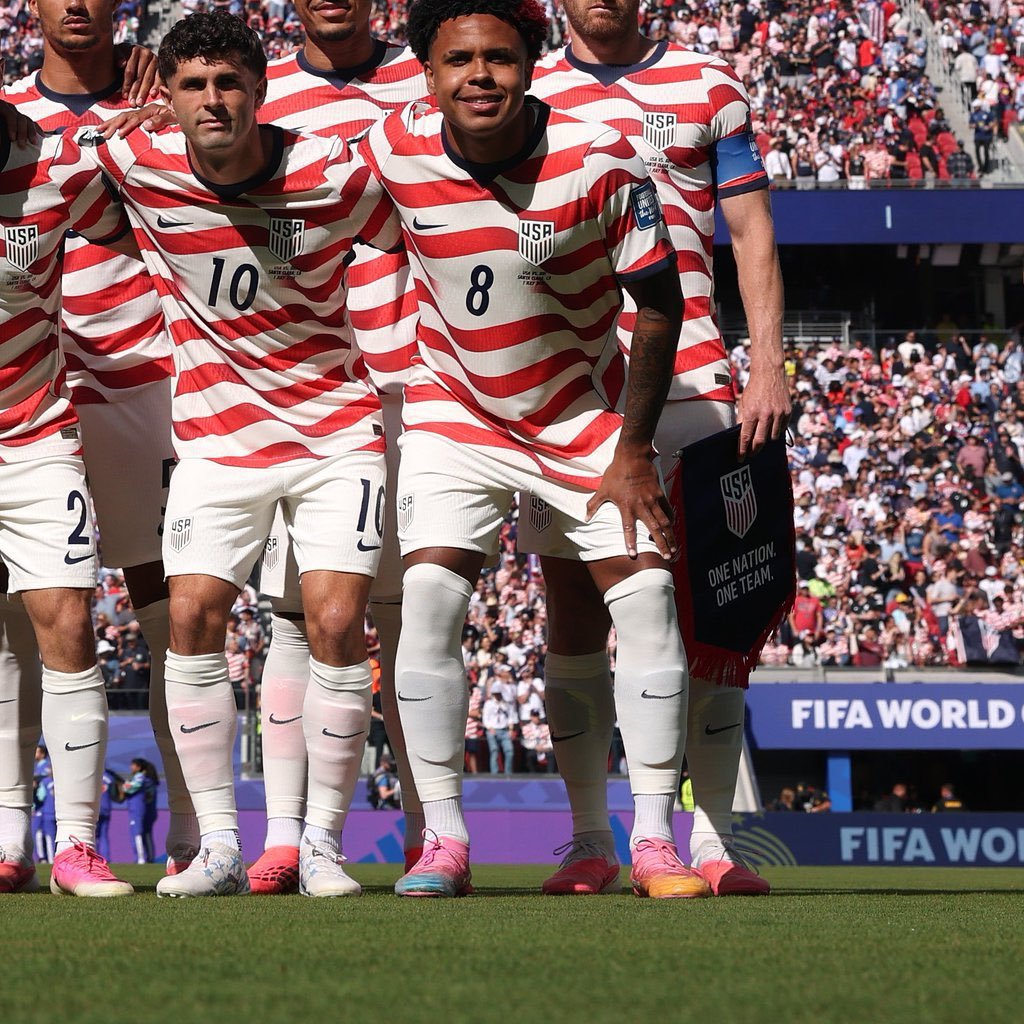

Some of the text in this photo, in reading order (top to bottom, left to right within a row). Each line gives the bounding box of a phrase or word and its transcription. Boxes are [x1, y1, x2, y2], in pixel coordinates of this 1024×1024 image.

[646, 113, 675, 129] USA
[7, 226, 36, 246] USA
[271, 219, 303, 238] USA
[521, 222, 552, 241] USA
[208, 257, 259, 311] 10
[465, 264, 494, 317] 8
[721, 470, 751, 501] USA
[67, 489, 90, 545] 2
[171, 518, 191, 532] USA
[356, 478, 386, 539] 10
[708, 541, 777, 588] ONE NATION.
[716, 564, 774, 607] ONE TEAM.
[791, 699, 874, 730] FIFA
[876, 698, 1016, 730] WORLD
[839, 826, 1024, 864] FIFA WO
